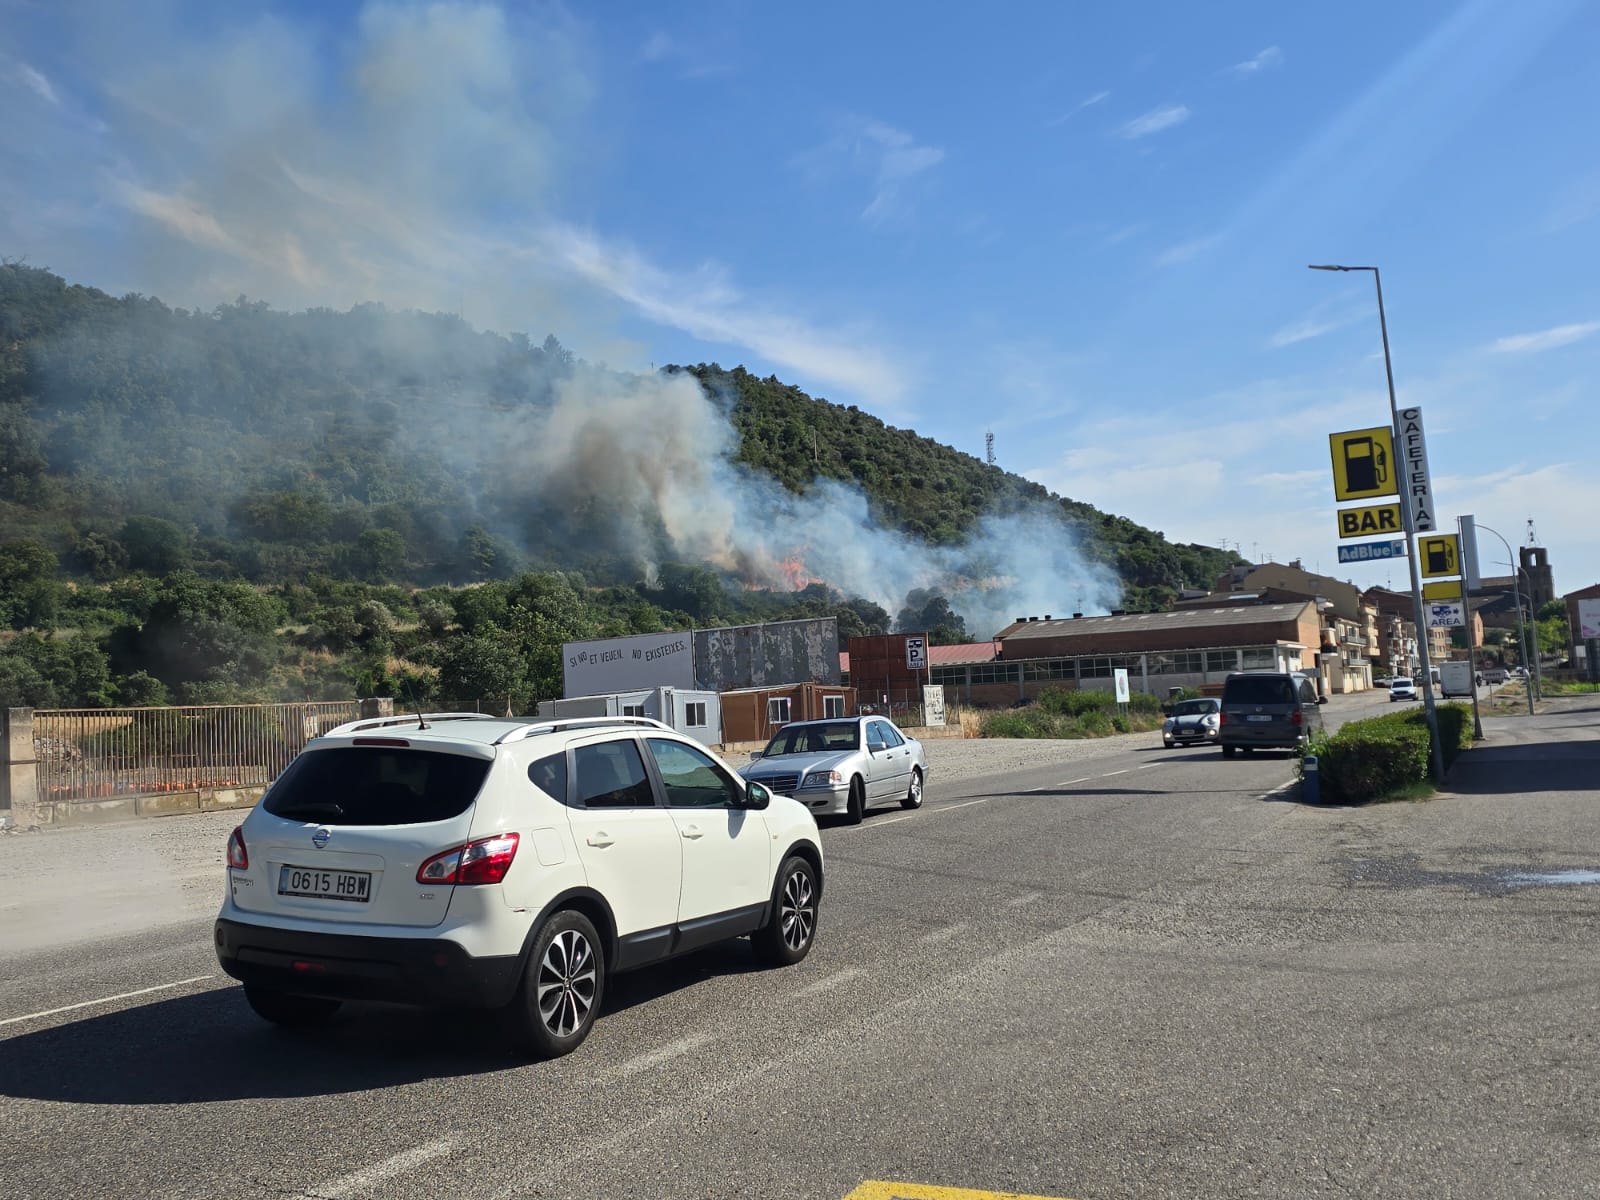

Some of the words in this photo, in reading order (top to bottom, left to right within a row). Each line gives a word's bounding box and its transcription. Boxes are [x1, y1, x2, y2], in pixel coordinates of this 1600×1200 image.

[1402, 408, 1432, 522] CAFETERIA
[1342, 508, 1397, 534] BAR
[1340, 545, 1391, 561] AdBlue
[1431, 617, 1461, 626] AREA
[589, 653, 599, 665] ET
[631, 648, 642, 660] NO
[910, 649, 919, 662] P
[291, 871, 330, 892] 0615
[336, 874, 367, 895] HBW
